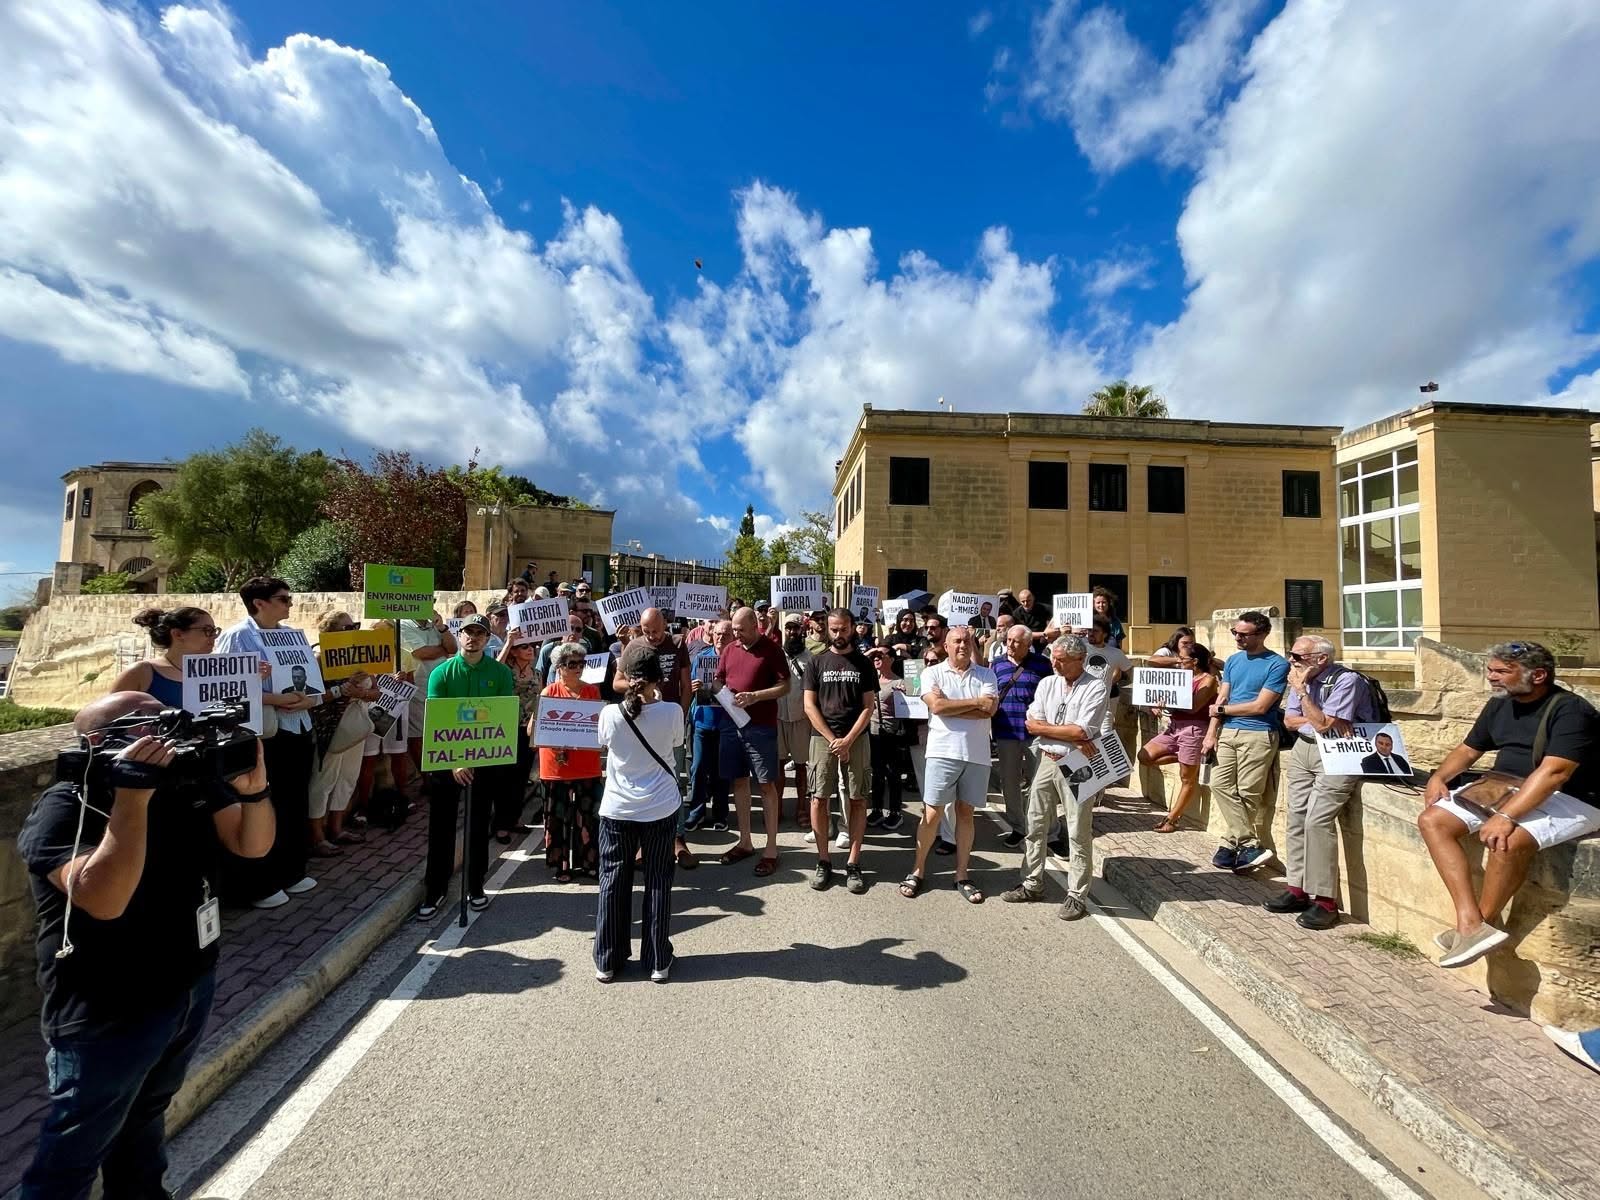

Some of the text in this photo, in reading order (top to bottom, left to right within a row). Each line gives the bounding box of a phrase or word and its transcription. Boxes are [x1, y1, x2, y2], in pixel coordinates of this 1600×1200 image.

[776, 577, 817, 592] KORROTTI
[854, 586, 878, 597] KORROTTI
[367, 591, 434, 601] ENVIRONMENT
[652, 588, 677, 597] KORROTTI
[952, 595, 979, 604] NADDFU
[381, 604, 420, 612] =HEALTH
[601, 590, 644, 614] KORROTTI
[654, 598, 672, 608] BARRA
[782, 596, 811, 610] BARRA
[855, 597, 873, 608] BARRA
[1056, 596, 1088, 609] KORROTTI
[519, 601, 562, 622] INTEGRITÀ
[1060, 613, 1082, 626] BARRA
[259, 631, 307, 647] KORROTTI
[275, 650, 309, 666] BARRA
[324, 643, 391, 668] IRRIŻENJA
[187, 655, 258, 678] KORROTTI
[1139, 670, 1186, 687] KORROTTI
[199, 680, 248, 702] BARRA
[1145, 689, 1178, 705] BARRA
[427, 745, 514, 764] TAL-ĦAJJA
[1100, 733, 1131, 777] KORROTTI
